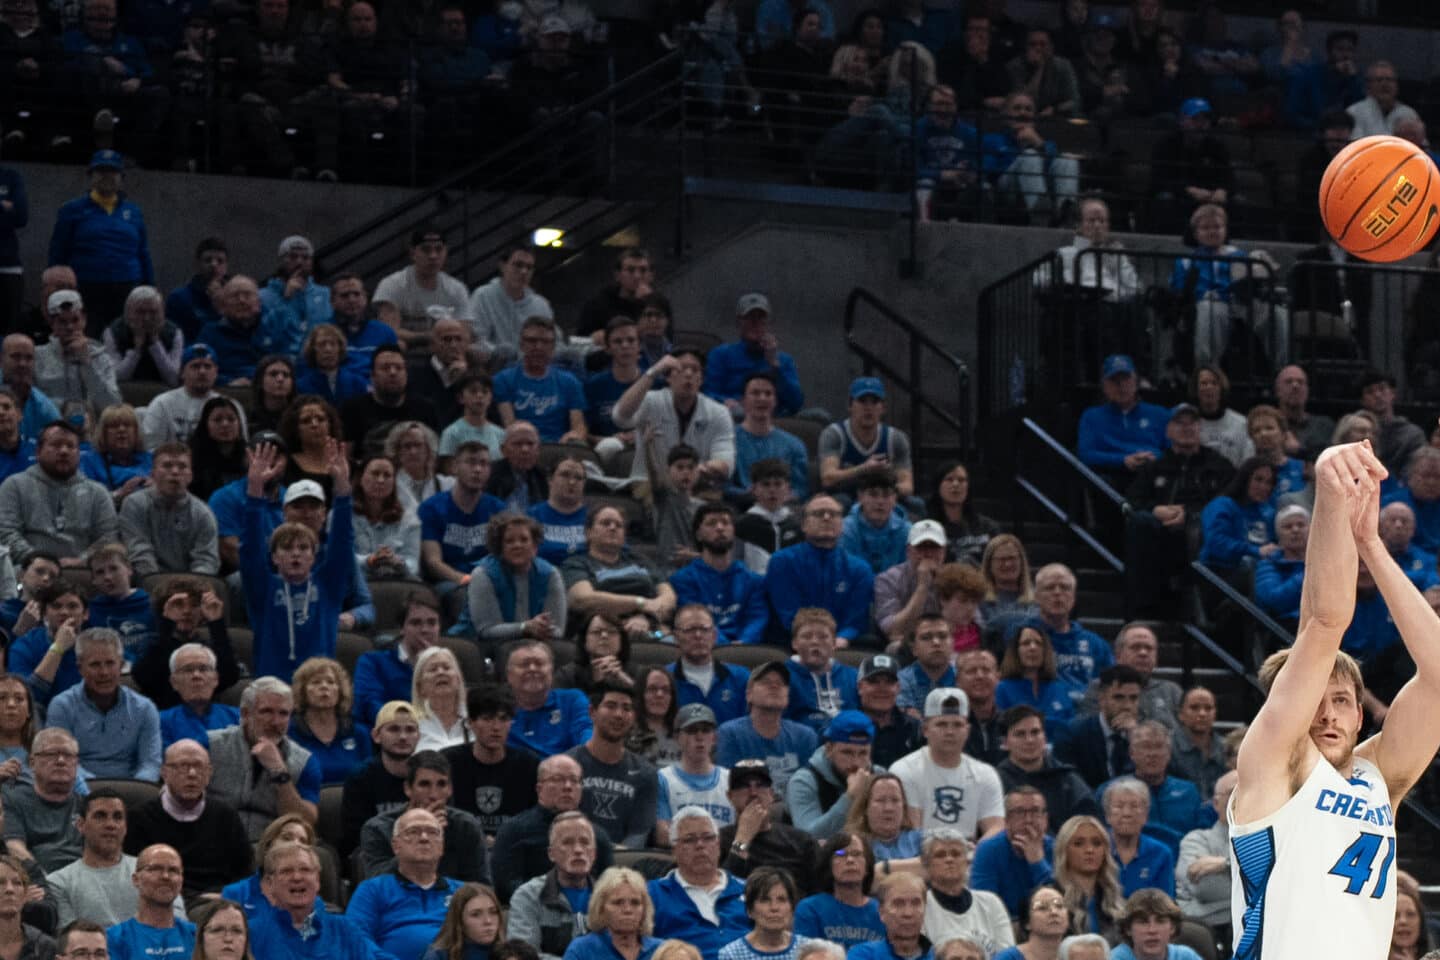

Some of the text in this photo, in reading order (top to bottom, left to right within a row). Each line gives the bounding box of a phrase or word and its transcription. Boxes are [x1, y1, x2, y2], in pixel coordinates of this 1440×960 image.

[1366, 181, 1418, 238] ELITE
[582, 776, 634, 798] XAVIER
[1327, 831, 1395, 899] 41
